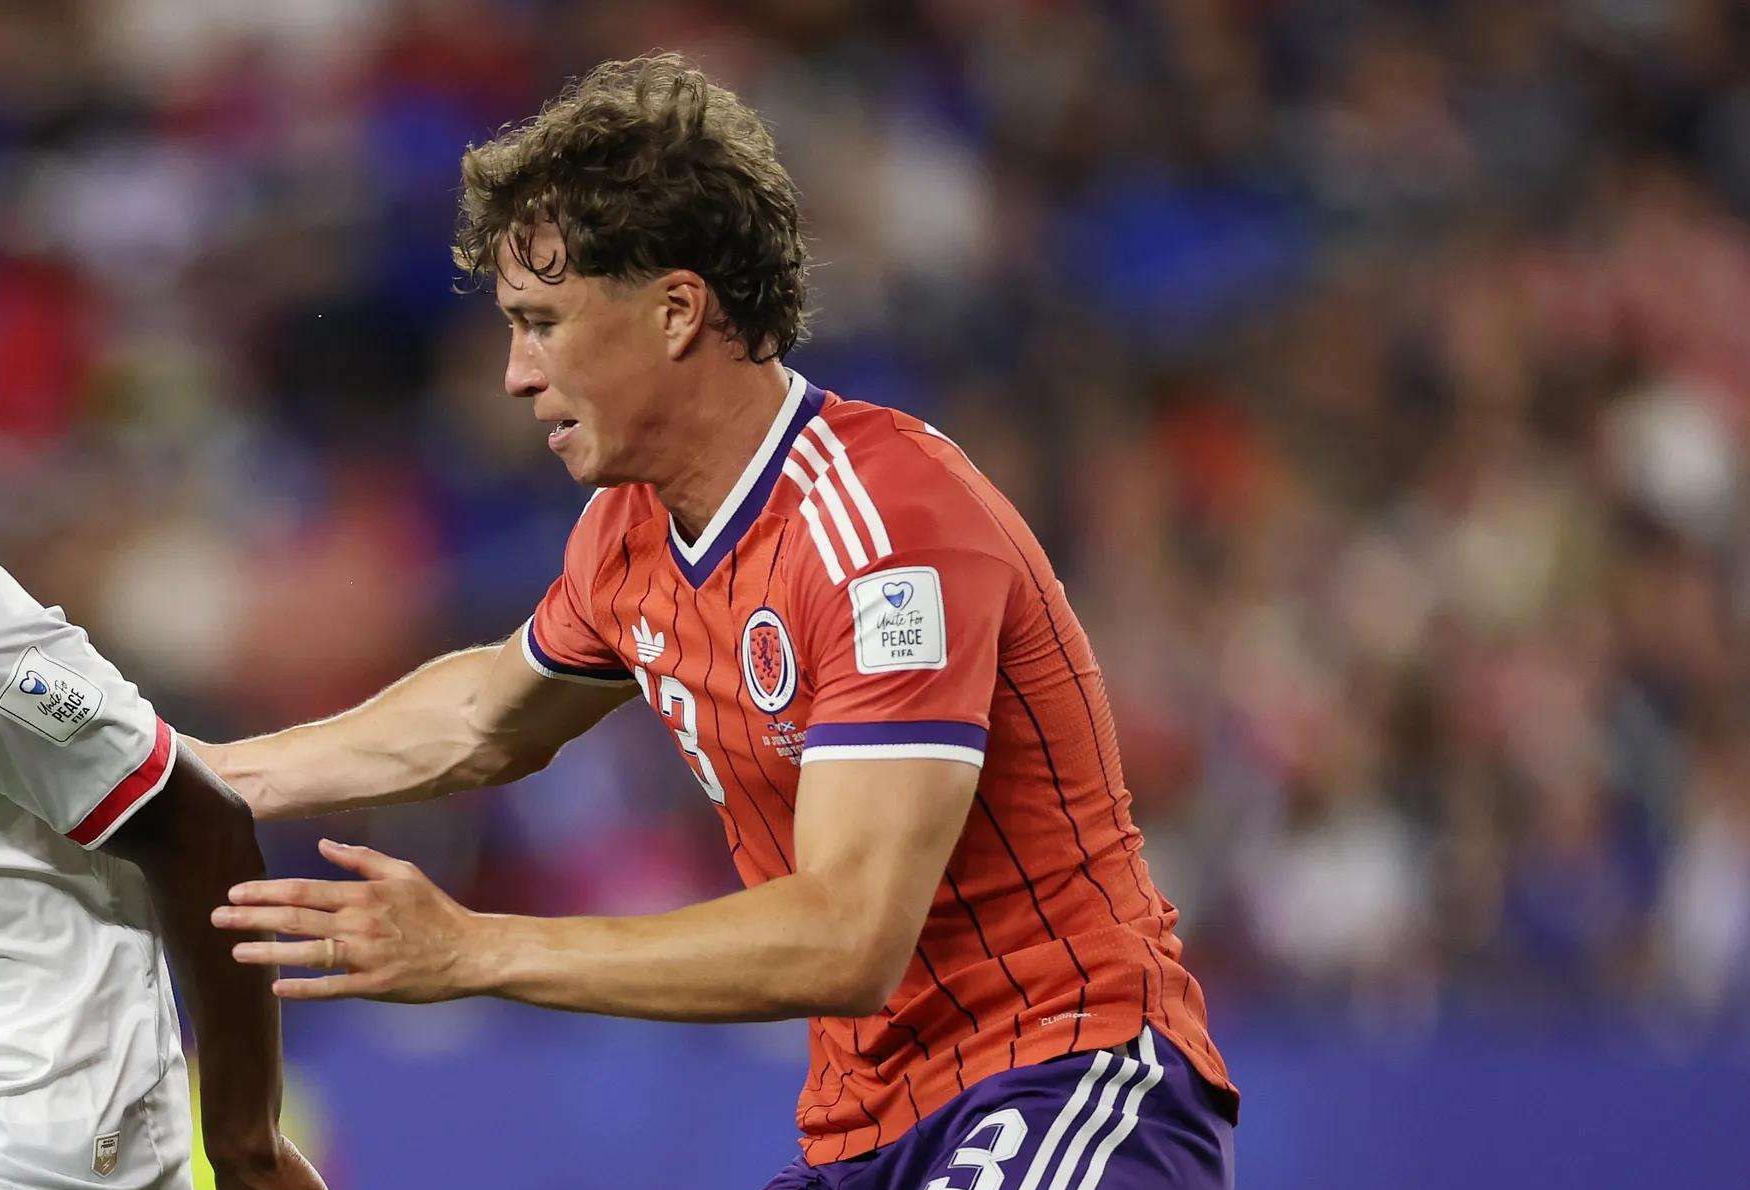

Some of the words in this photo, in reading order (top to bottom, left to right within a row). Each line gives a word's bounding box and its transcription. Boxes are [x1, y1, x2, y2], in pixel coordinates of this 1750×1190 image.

[877, 611, 906, 630] Unite
[907, 609, 924, 627] For
[881, 628, 923, 647] PEACE
[891, 649, 914, 658] FIFA
[51, 688, 85, 723] PEACE
[71, 707, 91, 724] FIFA
